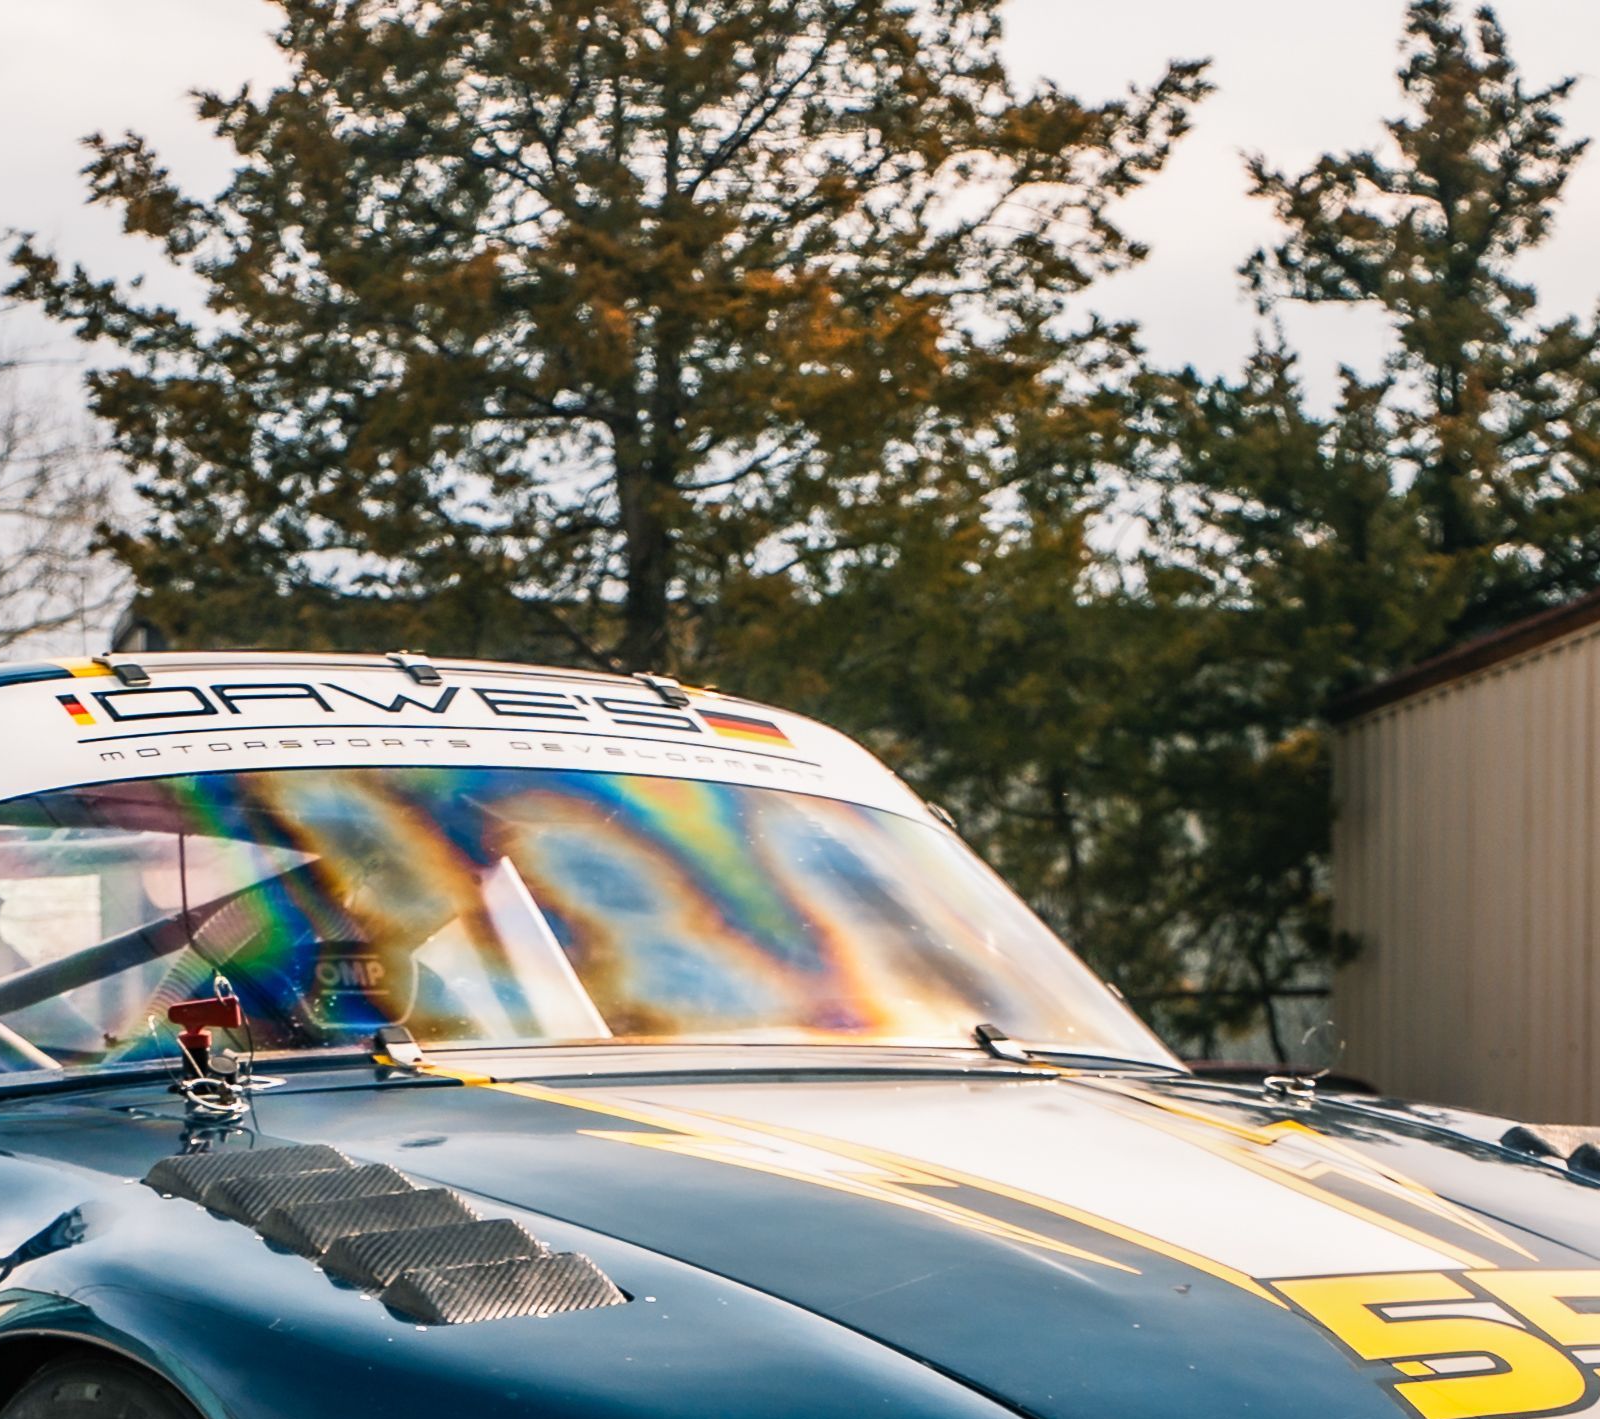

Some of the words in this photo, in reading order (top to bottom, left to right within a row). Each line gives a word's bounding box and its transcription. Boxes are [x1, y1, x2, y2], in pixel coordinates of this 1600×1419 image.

[91, 682, 703, 733] DAWE'S
[99, 738, 472, 763] MOTORSPORTS
[314, 960, 386, 987] OMP
